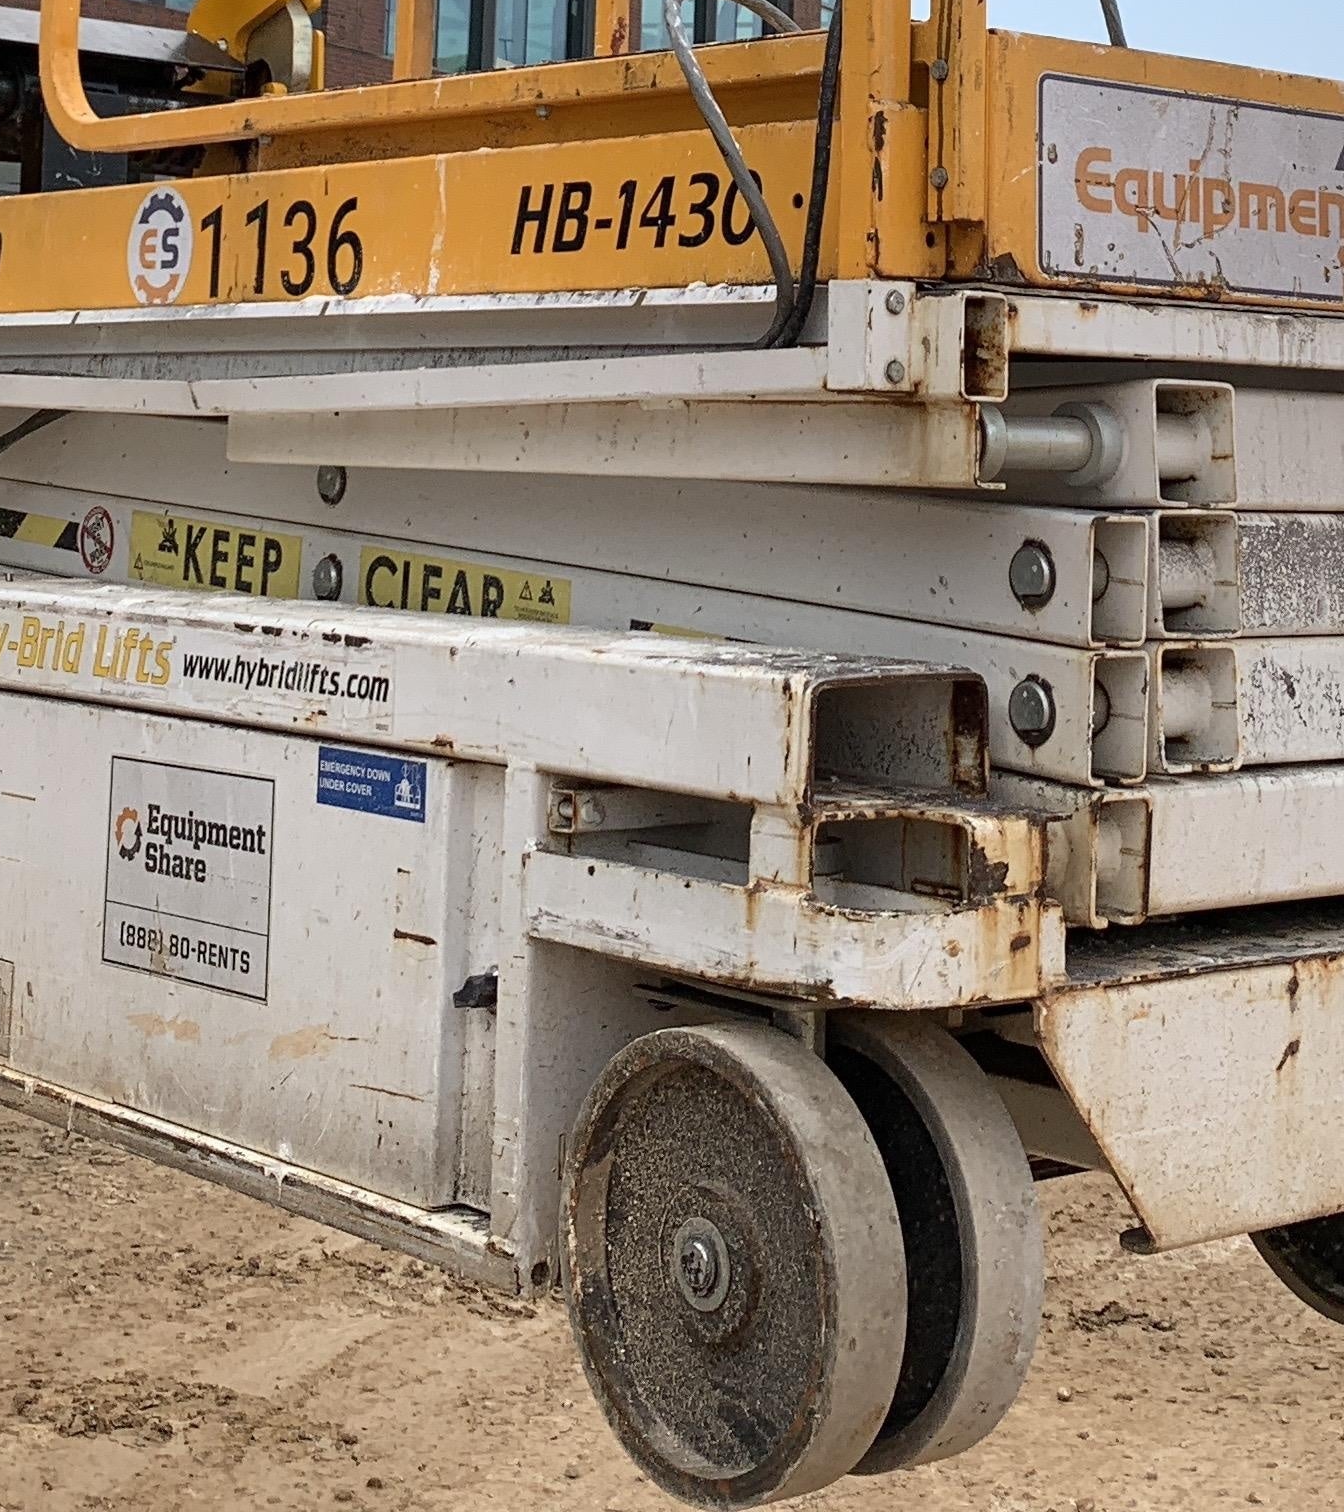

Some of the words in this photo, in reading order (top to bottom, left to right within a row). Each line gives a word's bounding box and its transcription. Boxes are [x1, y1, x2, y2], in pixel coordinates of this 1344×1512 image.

[139, 227, 179, 270] ES
[199, 196, 365, 299] 1136
[509, 168, 763, 255] HB-1430
[182, 524, 283, 596] KEEP
[92, 624, 174, 685] Lifts
[182, 650, 391, 703] www.hybridlifts.com
[319, 777, 345, 792] UNDER
[345, 781, 373, 797] COVER
[320, 759, 366, 778] EMERGENCY
[366, 768, 391, 782] DOWN
[146, 803, 266, 855] Equipment
[144, 841, 207, 883] Share
[169, 934, 251, 975] 80-RENTS
